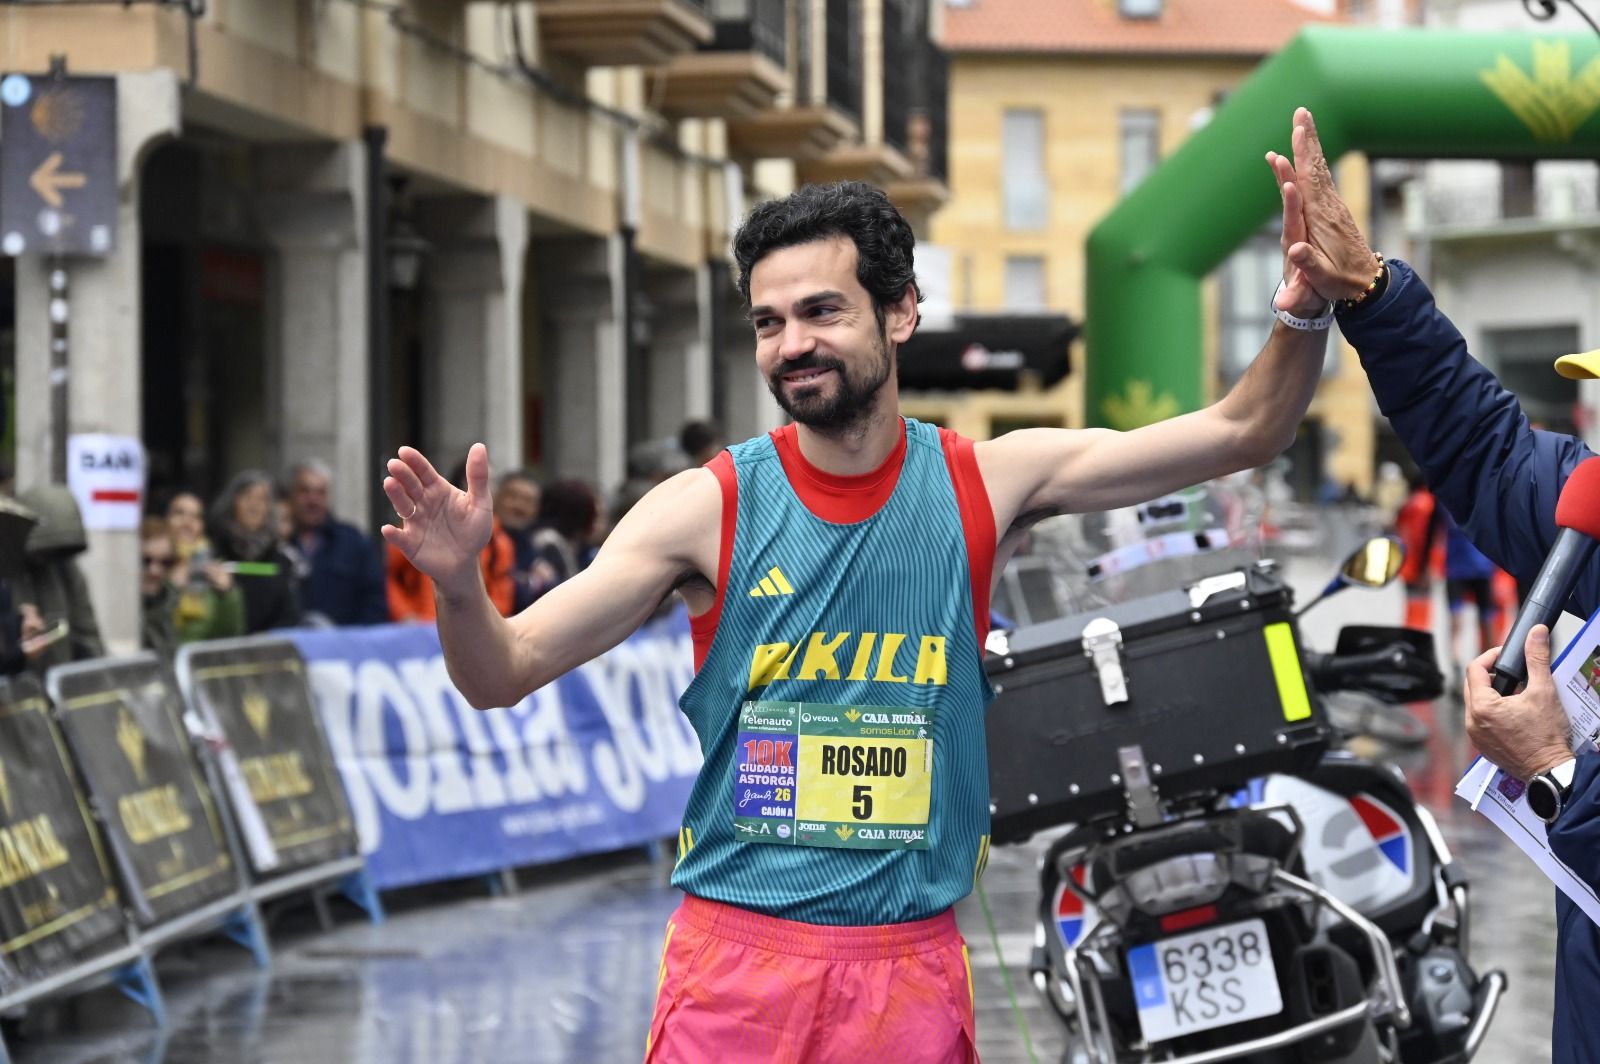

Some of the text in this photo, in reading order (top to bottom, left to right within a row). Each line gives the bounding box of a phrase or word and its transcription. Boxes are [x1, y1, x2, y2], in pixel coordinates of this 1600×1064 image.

[743, 715, 793, 727] Telenauto
[861, 713, 928, 725] CAJA RURAL
[743, 739, 793, 767] 10K
[821, 744, 907, 778] ROSADO
[739, 763, 795, 775] CIUDAD DE
[738, 773, 795, 787] ASTORGA
[774, 787, 791, 802] 26
[852, 785, 873, 821] 5
[761, 806, 793, 817] CAJÓN A
[857, 828, 886, 840] CAJA
[1163, 931, 1262, 984] 6338
[1171, 977, 1246, 1026] KSS
